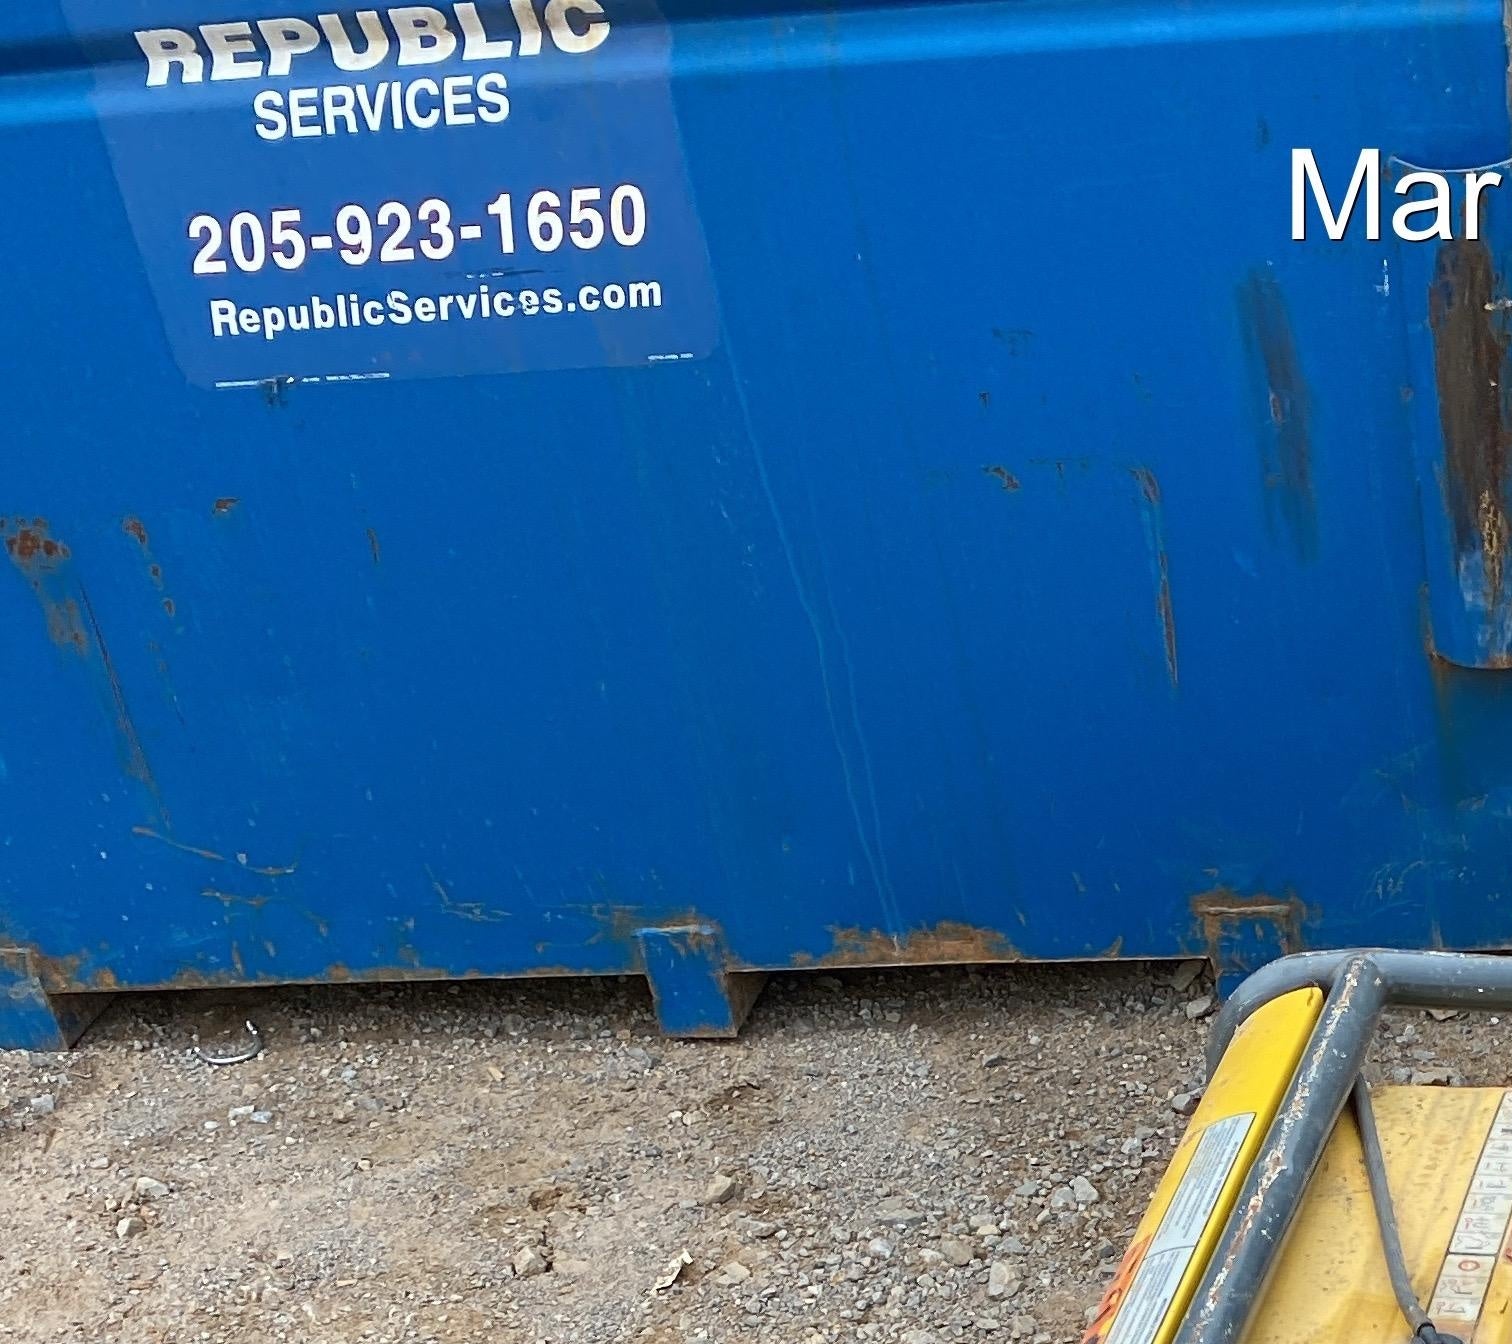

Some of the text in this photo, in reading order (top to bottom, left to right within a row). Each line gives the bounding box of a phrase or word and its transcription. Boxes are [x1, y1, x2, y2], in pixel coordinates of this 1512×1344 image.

[134, 0, 611, 87] REPUBLIC
[253, 73, 511, 141] SERVICES
[187, 184, 647, 275] 205-923-1650
[210, 279, 663, 341] RepublicServices.com
